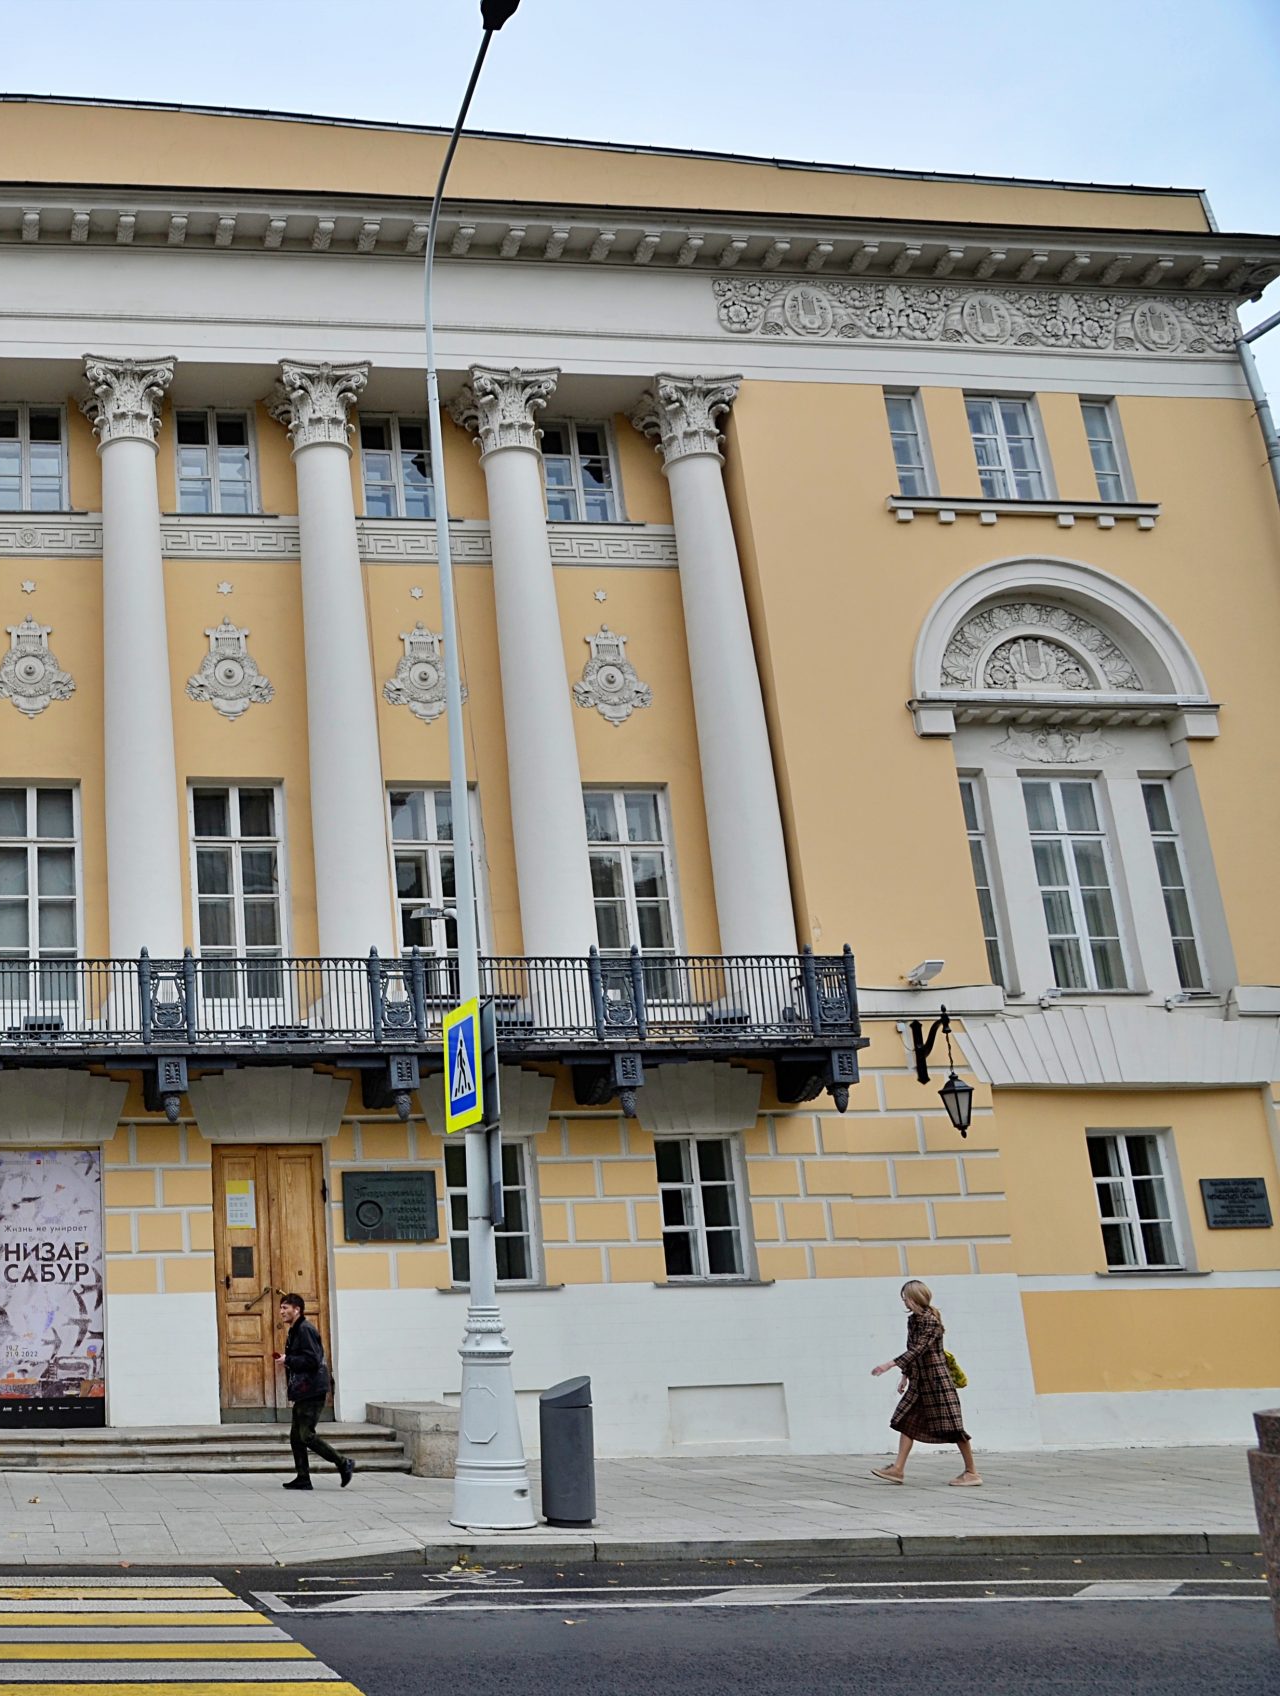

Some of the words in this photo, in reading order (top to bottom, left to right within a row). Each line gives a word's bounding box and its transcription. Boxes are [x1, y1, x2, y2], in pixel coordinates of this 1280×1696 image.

[4, 1225, 33, 1233] Жизнь
[50, 1225, 88, 1233] умирает
[4, 1242, 89, 1262] НИЗАР
[4, 1263, 90, 1283] САБУР
